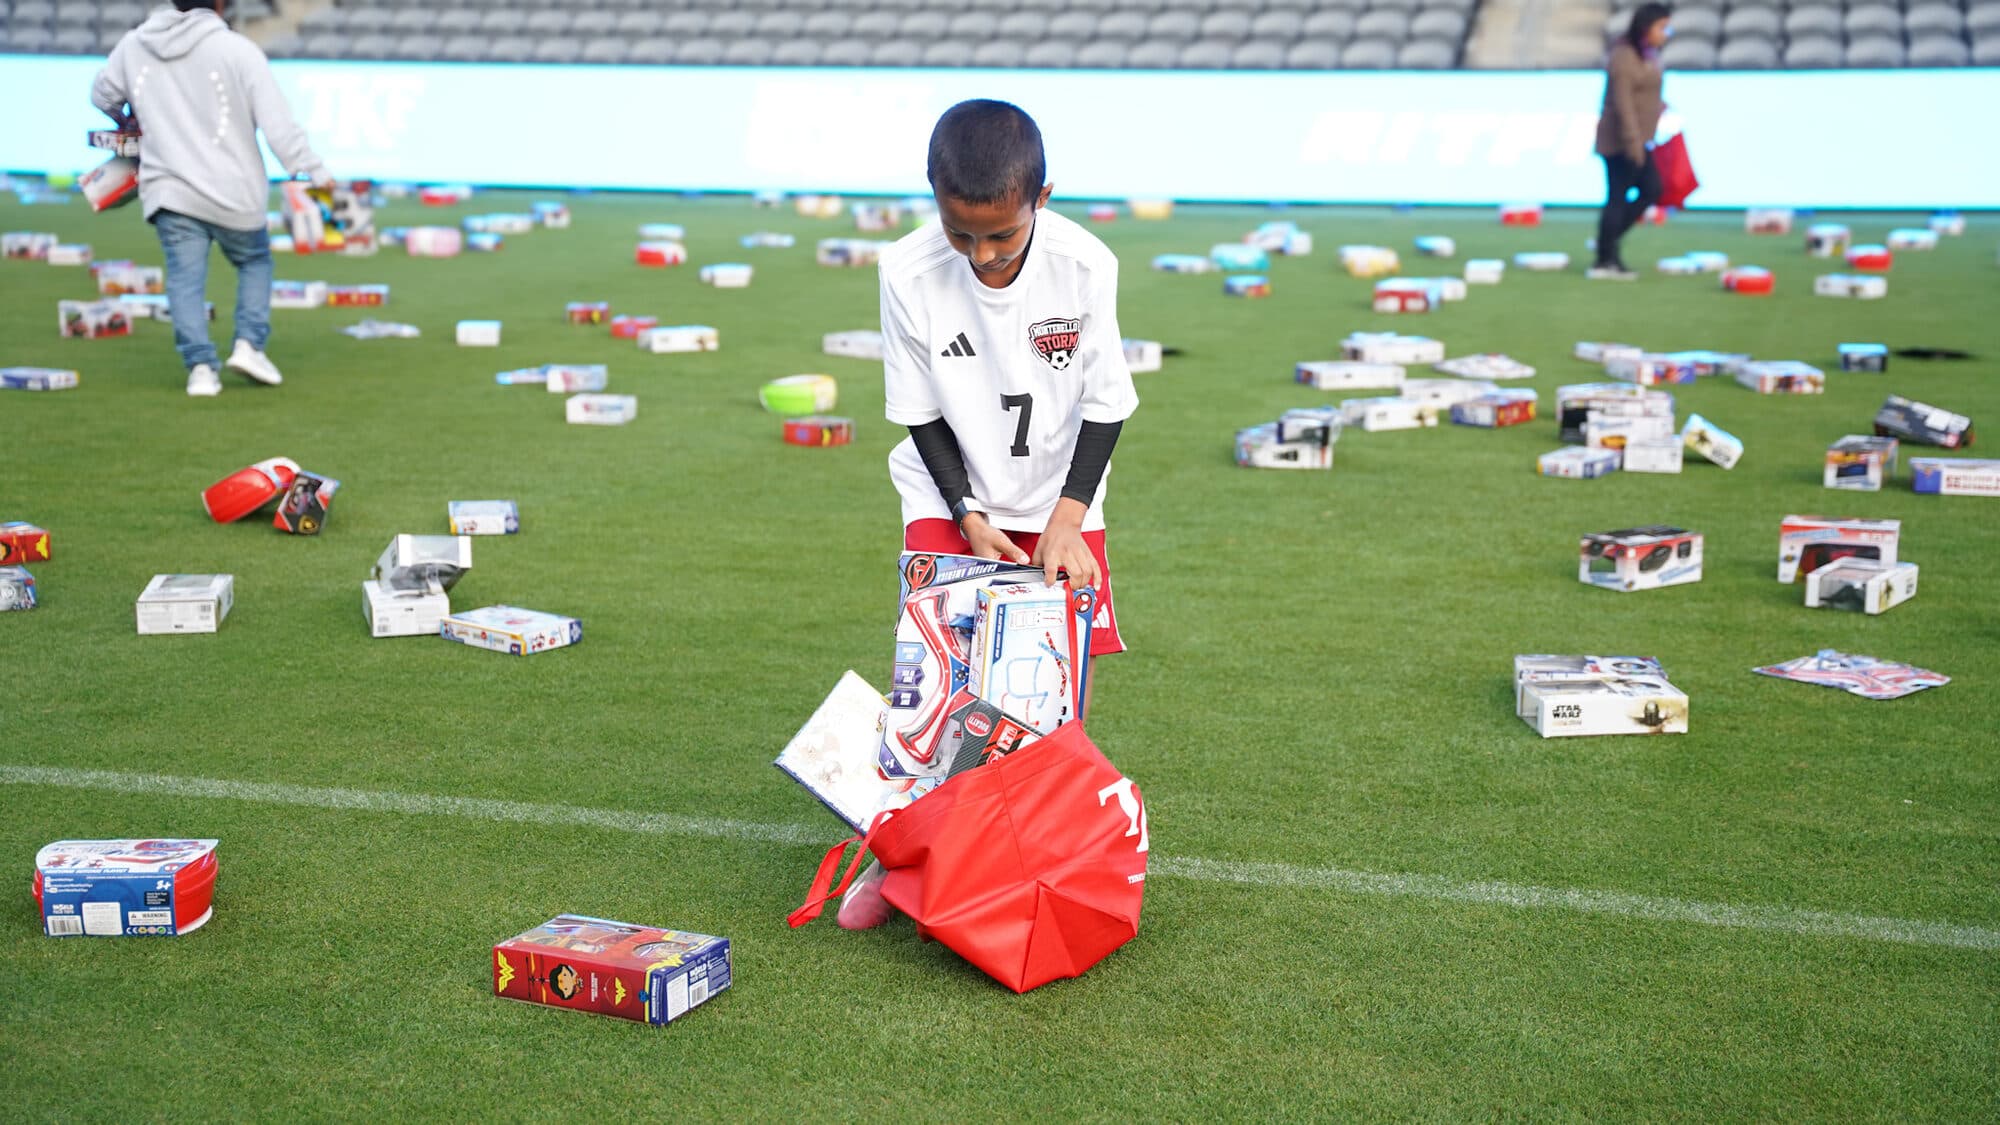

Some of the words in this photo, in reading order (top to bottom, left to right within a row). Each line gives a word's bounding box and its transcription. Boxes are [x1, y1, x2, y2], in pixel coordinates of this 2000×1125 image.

[1035, 333, 1080, 352] STORM
[1000, 393, 1033, 456] 7
[967, 563, 998, 578] CAPTAIN
[1552, 704, 1582, 712] STAR
[1552, 711, 1581, 719] WARS
